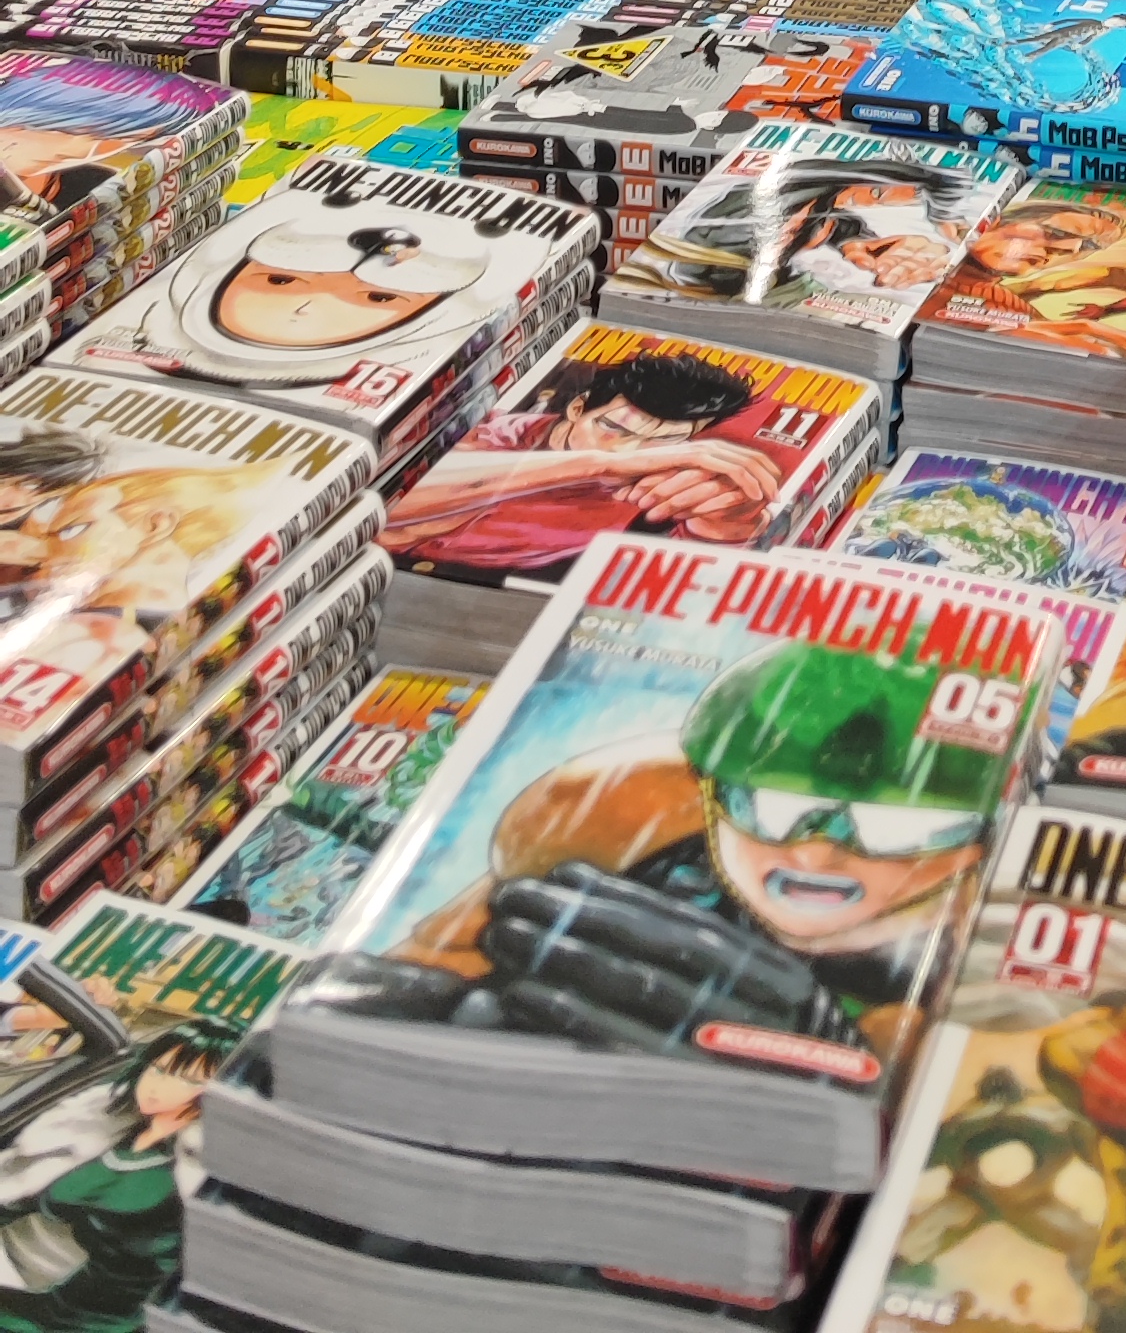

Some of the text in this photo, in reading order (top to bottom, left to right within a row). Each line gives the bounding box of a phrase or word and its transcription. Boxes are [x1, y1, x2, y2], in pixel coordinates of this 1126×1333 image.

[859, 107, 917, 124] KUROKAWA
[475, 140, 533, 157] KUROKAWA
[290, 158, 587, 241] ONE-PUNCH MAN
[345, 361, 404, 399] 15
[775, 363, 870, 416] MAN
[1, 373, 352, 482] ONE-PUNCH MAN
[769, 405, 823, 438] 11
[585, 543, 918, 660] ONE-PUNCH
[916, 599, 1052, 681] MAN
[565, 634, 722, 673] YUSUKE MURATA
[1, 660, 67, 715] 14
[930, 673, 1021, 731] 05
[336, 731, 410, 771] 10
[1015, 901, 1100, 978] 01
